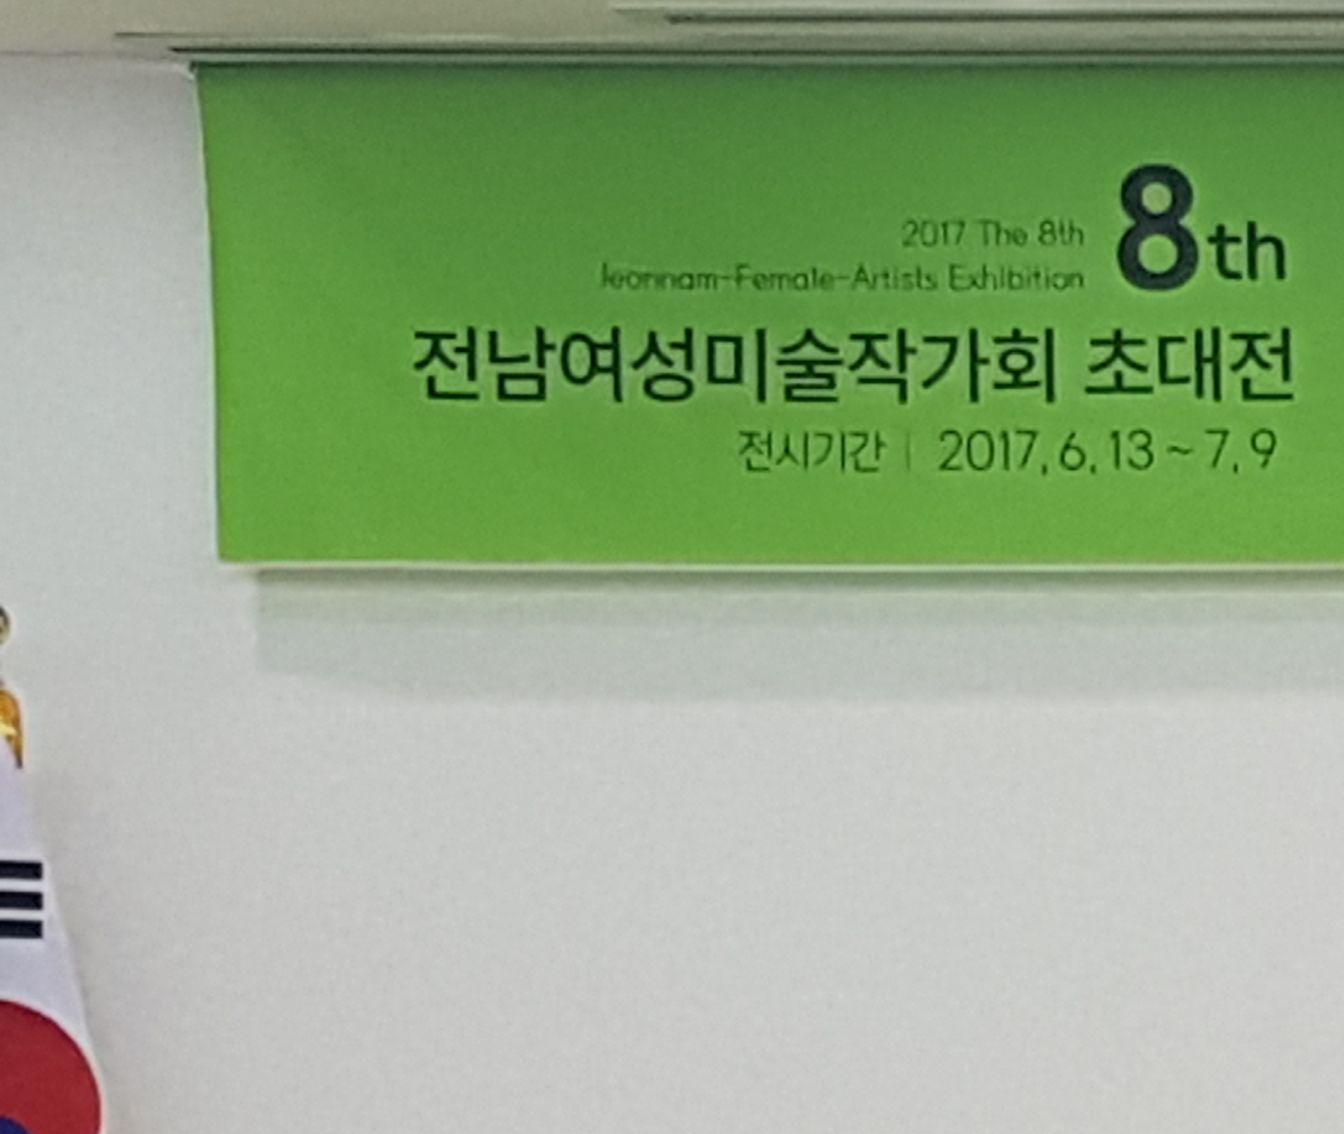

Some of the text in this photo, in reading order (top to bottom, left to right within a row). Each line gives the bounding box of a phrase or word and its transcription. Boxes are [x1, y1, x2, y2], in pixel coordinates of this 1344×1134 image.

[902, 219, 1086, 249] 2017 The 8th
[1117, 164, 1288, 294] 8th
[948, 264, 1086, 293] Exhibition
[412, 325, 1296, 407] 전남여성미술작가회 초대전
[738, 429, 888, 476] 전시기간
